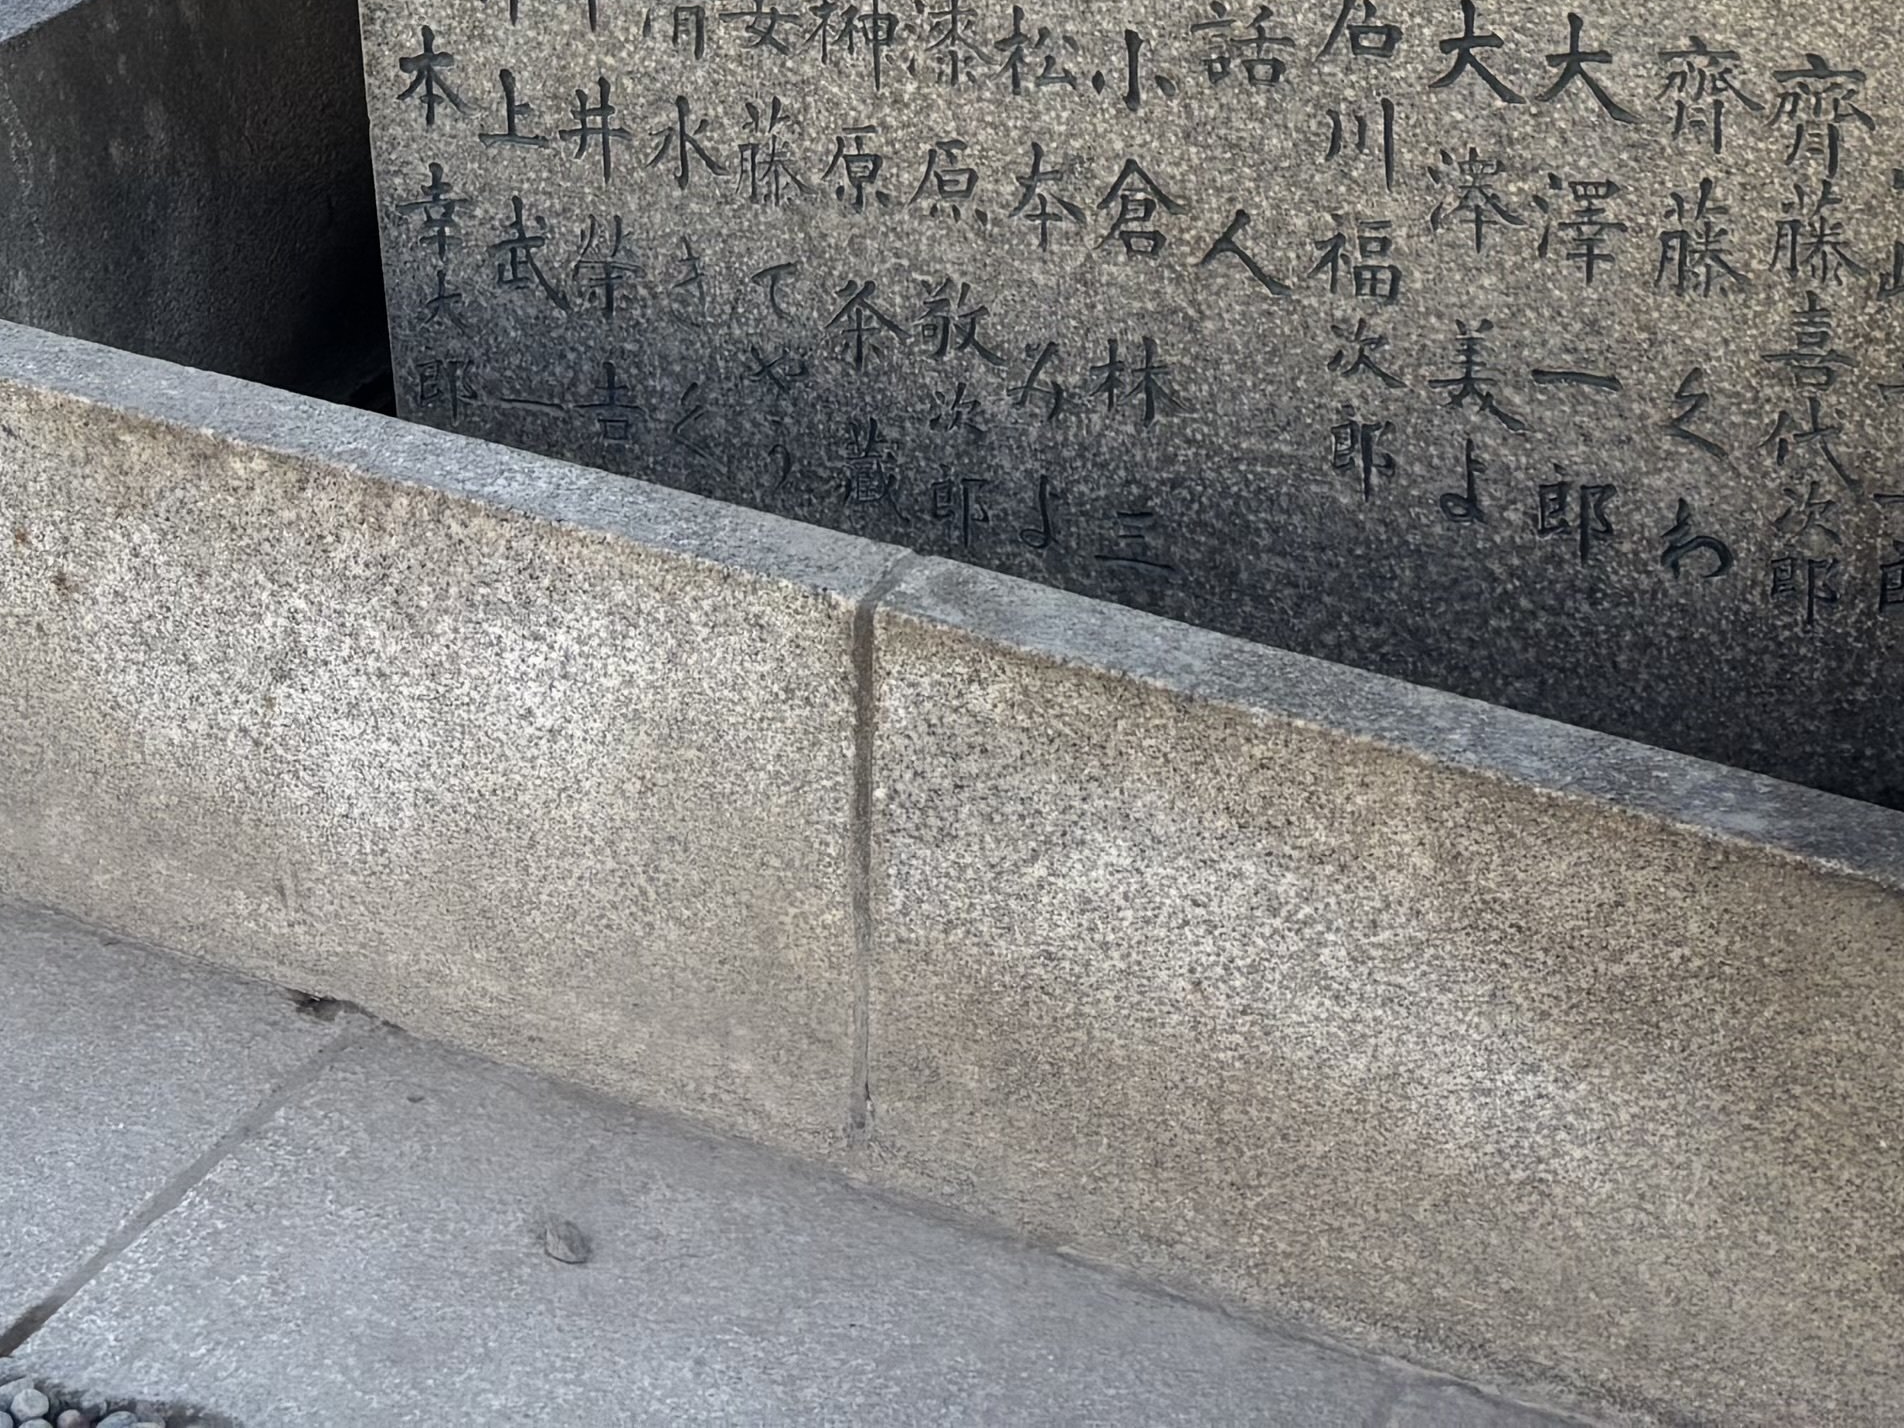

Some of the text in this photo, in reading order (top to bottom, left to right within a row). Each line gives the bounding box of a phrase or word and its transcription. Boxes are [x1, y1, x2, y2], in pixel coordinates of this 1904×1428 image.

[1091, 30, 1188, 571] 小倉林三
[1532, 13, 1642, 563] 大澤一郎
